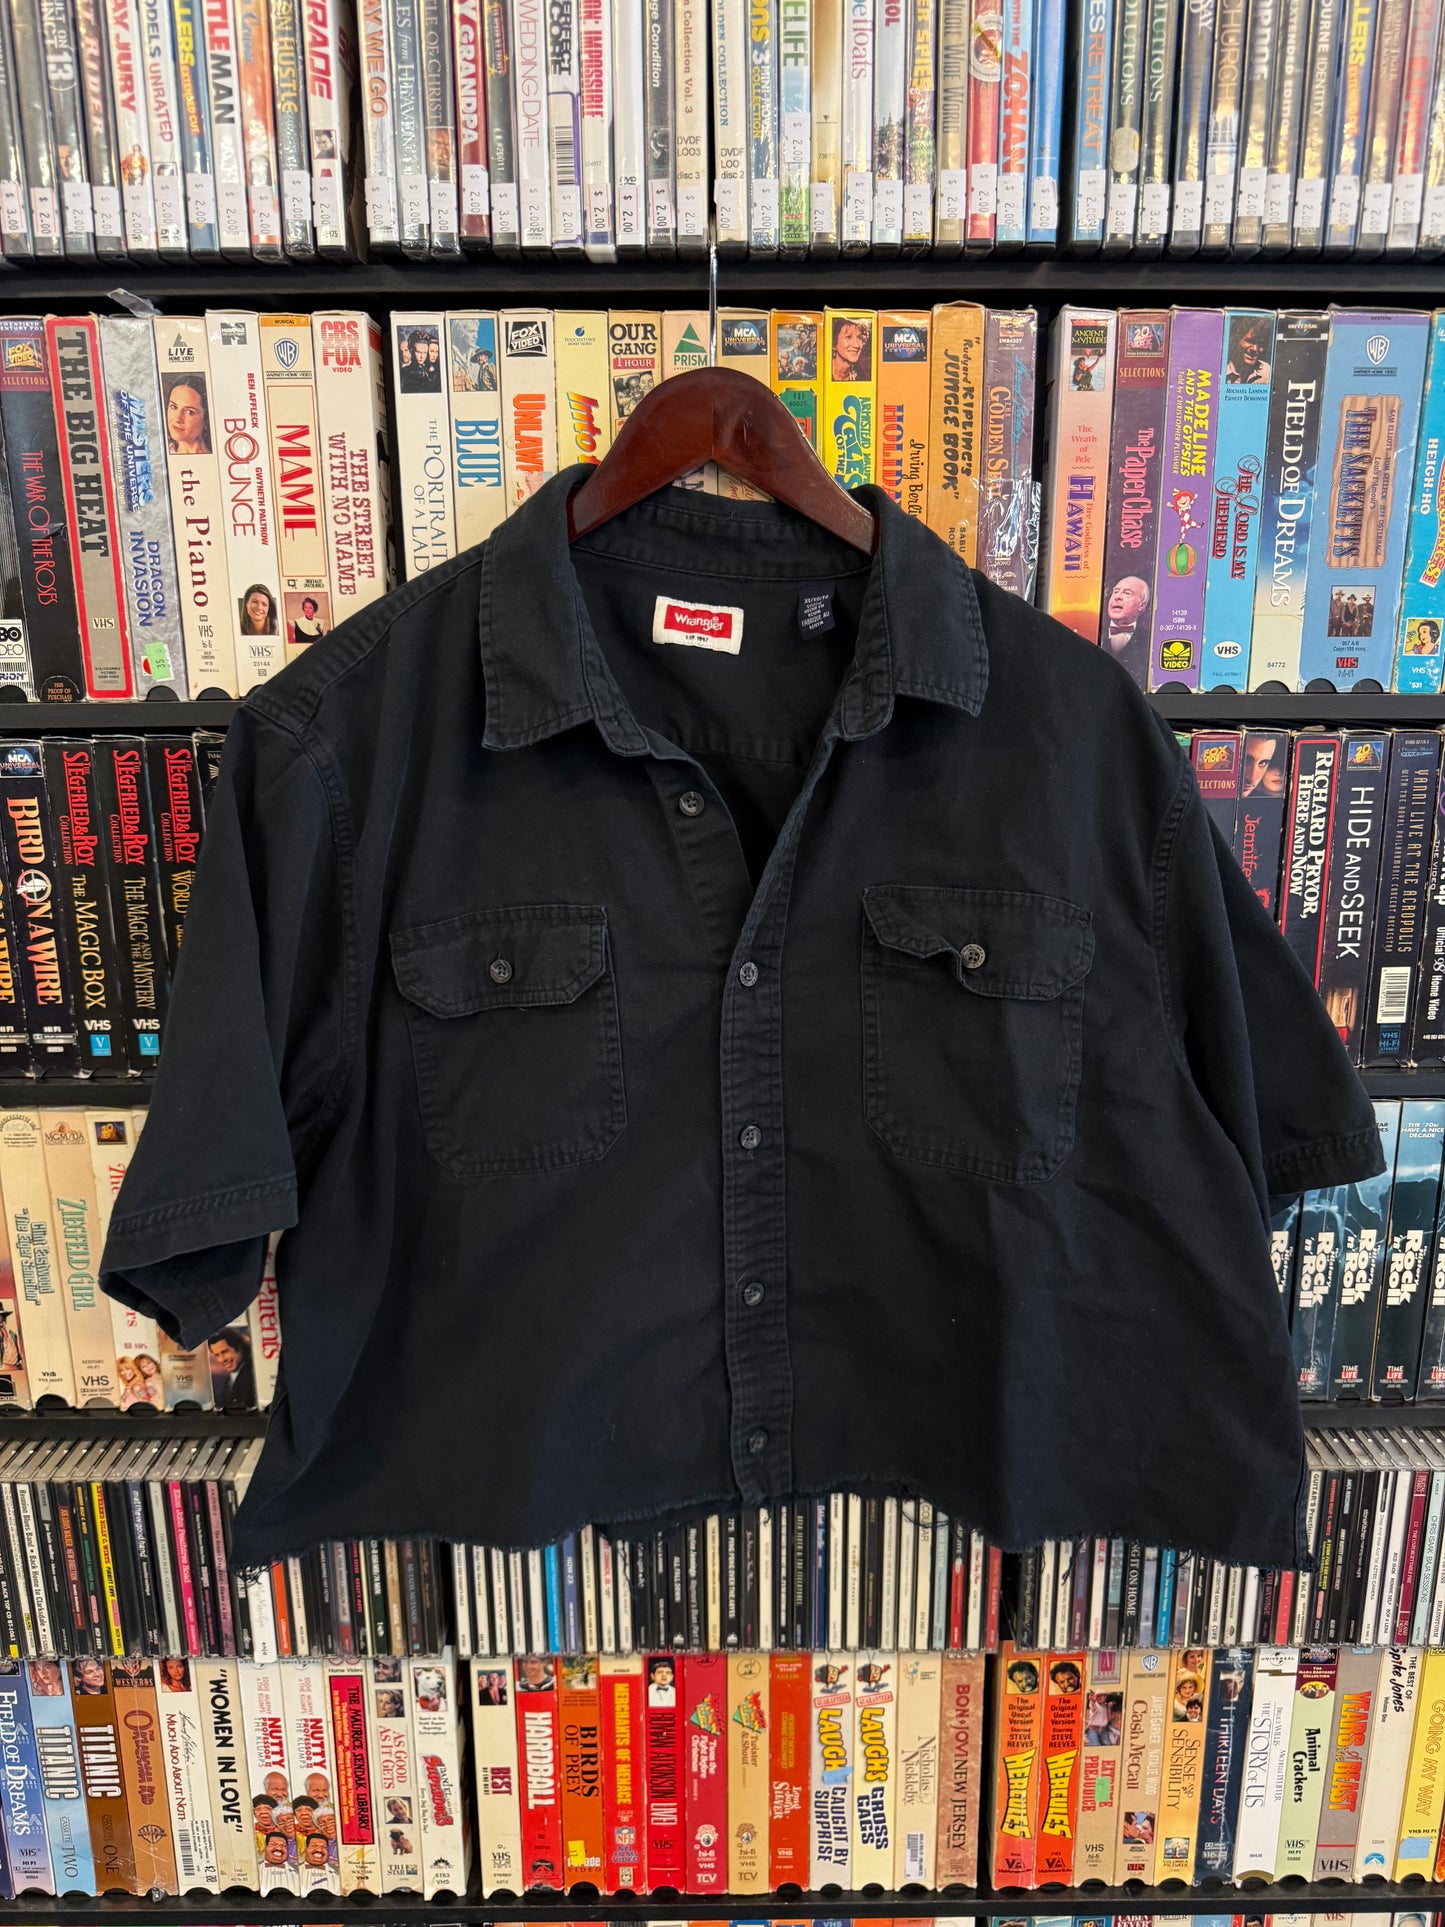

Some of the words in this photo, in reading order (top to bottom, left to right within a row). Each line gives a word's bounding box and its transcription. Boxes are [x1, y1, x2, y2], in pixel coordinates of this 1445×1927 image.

[651, 23, 661, 88] Condition
[682, 12, 694, 74] Collection
[943, 48, 959, 81] WIDE
[115, 37, 136, 113] JURY
[210, 53, 235, 124] MAN
[277, 37, 298, 113] HUSTLE
[427, 59, 443, 123] CHRIST
[460, 25, 478, 145] GRANDPA
[684, 77, 693, 100] Vol.
[718, 45, 729, 127] COLLECTION
[1314, 58, 1327, 117] IDENTITY
[149, 62, 173, 143] UNRATED
[368, 80, 388, 118] GO
[684, 105, 693, 114] 3
[943, 86, 964, 134] WORLD
[1002, 50, 1028, 173] ZOHAN
[521, 100, 541, 149] DATE
[677, 136, 701, 145] DVDF
[721, 148, 744, 157] DVDF
[677, 171, 692, 179] disc
[721, 171, 737, 179] disc
[739, 171, 744, 179] 2
[319, 202, 330, 225] 2.00
[470, 191, 481, 213] 2.00
[656, 205, 667, 228] 2.00
[979, 190, 989, 213] 2.00
[169, 347, 193, 356] LIVE
[321, 321, 359, 342] CBS
[510, 336, 541, 351] VIDEO
[511, 323, 539, 341] FOX
[610, 323, 658, 341] OUR
[612, 343, 657, 355] GANG
[734, 329, 756, 337] MCA
[57, 332, 92, 400] THE
[323, 345, 361, 366] FOX
[623, 359, 653, 367] HOUR
[673, 354, 708, 366] PRISM
[1120, 368, 1165, 378] SELECTIONS
[3, 377, 49, 385] SELECTIONS
[247, 373, 256, 389] BEN
[944, 349, 960, 428] JUNGLE
[1185, 368, 1195, 396] AND
[249, 393, 259, 428] AFFLECK
[428, 418, 438, 442] THE
[988, 386, 1011, 456] GOLDEN
[1182, 400, 1194, 423] THE
[1191, 369, 1212, 477] MADELINE
[1283, 380, 1316, 464] FIELD
[66, 411, 100, 464] BIG
[455, 418, 502, 488] BLUE
[1180, 425, 1192, 477] GYPSIES
[21, 450, 47, 473] THE
[224, 418, 259, 537] BOUNCE
[275, 425, 318, 541] MAME
[328, 432, 350, 492] WITH
[350, 448, 370, 492] THE
[1119, 445, 1155, 498] Paper
[1281, 466, 1301, 493] OF
[1420, 437, 1439, 515] HEIGH-HO
[25, 475, 47, 504] WAR
[181, 469, 201, 507] the
[424, 444, 449, 560] PORTRAIT
[28, 506, 50, 539] OF
[73, 473, 110, 557] HEAT
[260, 509, 269, 545] PALTROW
[332, 495, 354, 526] NO
[1063, 475, 1096, 571] HAWAII
[1120, 498, 1153, 549] Chase
[32, 538, 53, 558] THE
[352, 498, 375, 578] STREET
[1270, 496, 1306, 608] DREAMS
[35, 561, 58, 606] ROSES
[130, 531, 152, 626] INVASION
[147, 540, 166, 617] DRAGON
[186, 517, 212, 608] Piano
[335, 530, 357, 595] NAME
[674, 612, 724, 631] Wrangler
[1296, 774, 1314, 824] HERE
[1310, 750, 1334, 846] RICHARD
[1411, 769, 1428, 806] YANNI
[7, 797, 46, 864] BIRD
[1346, 786, 1375, 849] HIDE
[1409, 811, 1425, 838] LIVE
[58, 815, 73, 865] COLLECTION
[1293, 825, 1306, 854] AND
[1407, 843, 1421, 857] AT
[72, 875, 86, 898] THE
[1289, 855, 1305, 897] NOW
[1300, 849, 1325, 919] PRYOR,
[1343, 853, 1361, 892] AND
[1405, 863, 1420, 885] THE
[28, 922, 55, 940] A
[75, 901, 100, 966] MAGIC
[1336, 893, 1365, 960] SEEK
[1397, 890, 1418, 953] ACROPOLIS
[26, 937, 63, 1005] WIRE
[81, 969, 106, 1009] BOX
[132, 961, 156, 1009] MYSTERY
[1429, 975, 1442, 997] Home
[1427, 998, 1440, 1020] Video
[31, 1221, 48, 1248] Clint
[57, 1198, 90, 1270] ZIEGFELD
[34, 1249, 54, 1295] Eastwood
[67, 1273, 96, 1312] GIRL
[82, 1376, 110, 1386] VHS
[20, 1489, 29, 1513] Reunion
[1126, 1589, 1137, 1617] HOME
[114, 1678, 154, 1687] WESTERNS
[1390, 1677, 1405, 1713] Jones
[351, 1705, 364, 1750] MAURICE
[564, 1724, 580, 1746] OF
[614, 1683, 631, 1746] MERCHANTS
[1424, 1700, 1445, 1754] GOING
[79, 1725, 122, 1798] TITANIC
[268, 1717, 286, 1769] NUTTY
[525, 1711, 556, 1810] HARDBALL
[580, 1725, 599, 1798] BIRDS
[860, 1707, 890, 1783] LAUGHS
[1304, 1727, 1321, 1773] Animal
[217, 1756, 237, 1774] IN
[353, 1751, 367, 1790] SENDAK
[382, 1758, 395, 1790] GETS
[395, 1747, 408, 1784] GOOD
[565, 1755, 581, 1796] PREY
[1081, 1755, 1099, 1812] PREJUDICE
[1167, 1728, 1188, 1810] SENSIBILITY
[1292, 1751, 1308, 1803] Crackers
[1421, 1758, 1438, 1782] MY
[357, 1792, 370, 1831] LIBRARY
[1000, 1748, 1037, 1839] HERCULES
[1416, 1784, 1434, 1816] WAY
[814, 1790, 832, 1862] SURPRISE
[857, 1795, 875, 1845] GAGS
[871, 1785, 889, 1850] GROSS
[65, 1845, 79, 1878] TWO
